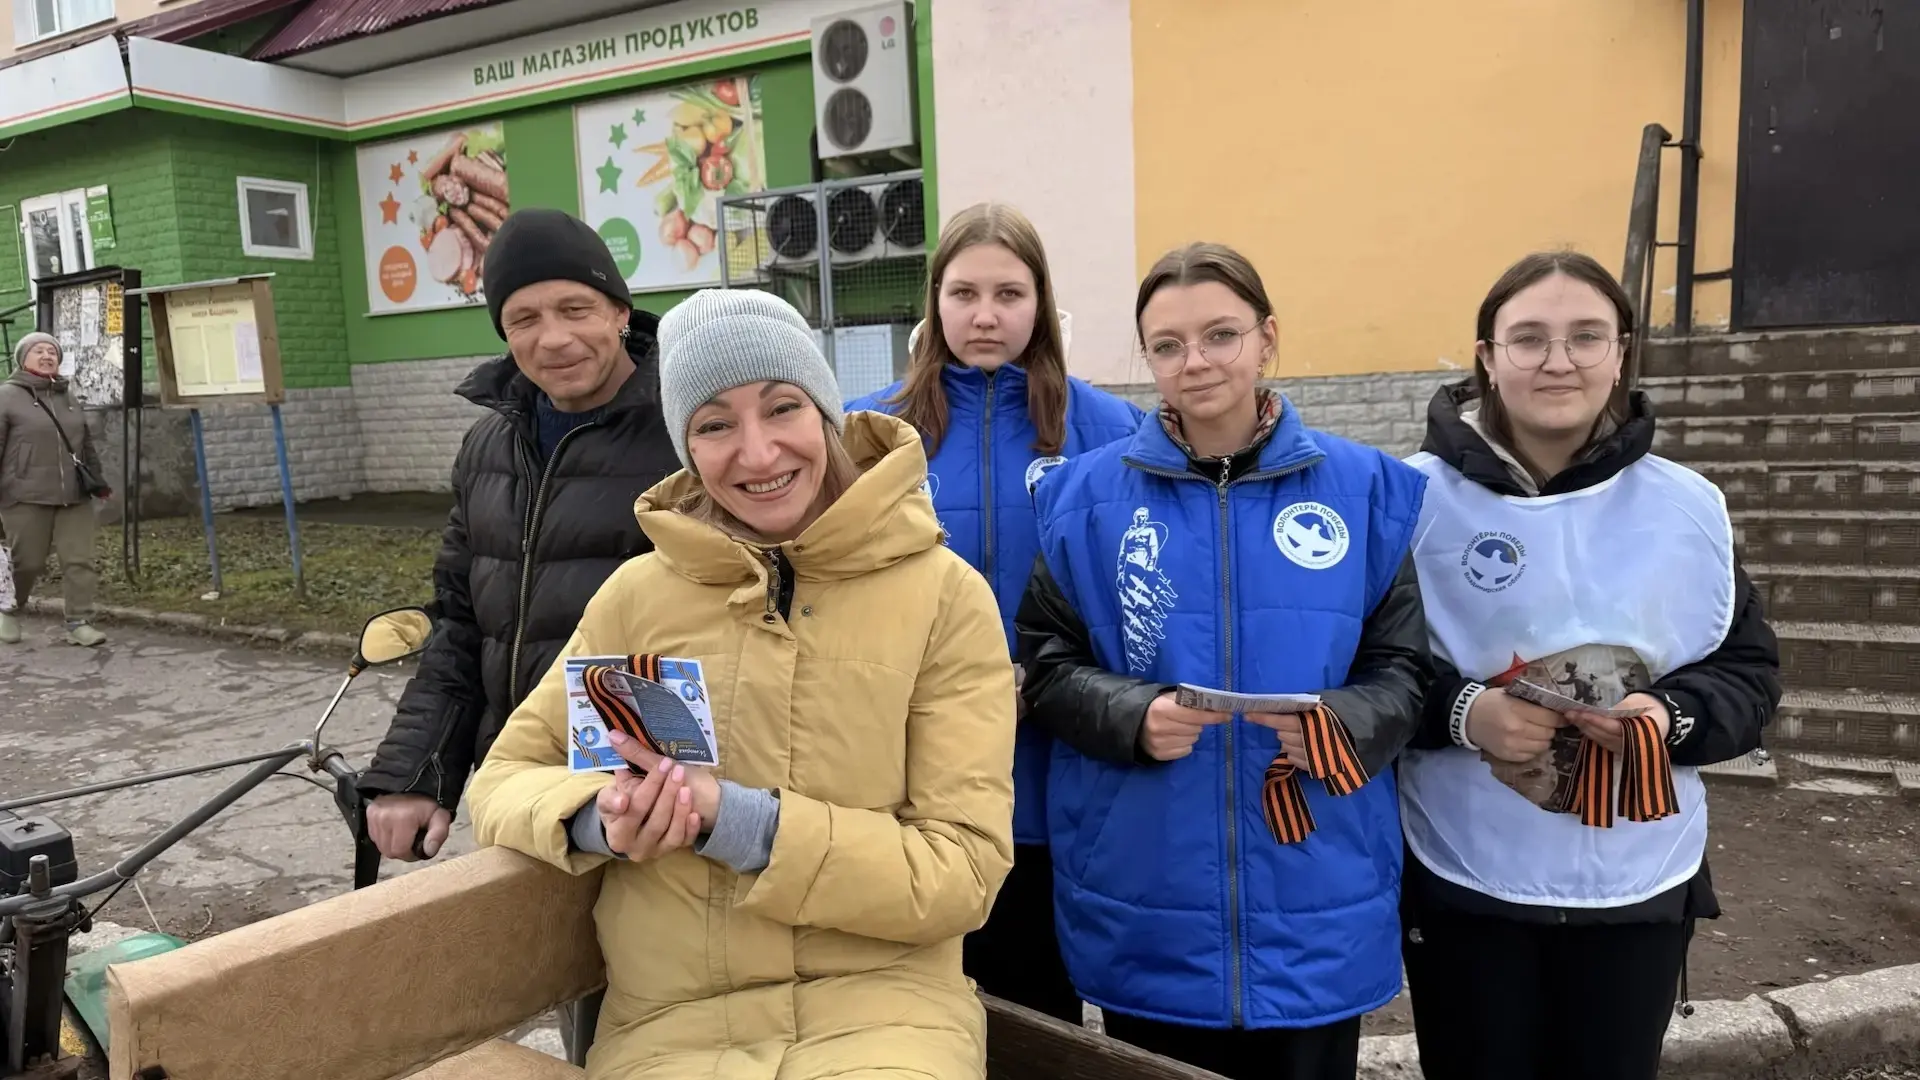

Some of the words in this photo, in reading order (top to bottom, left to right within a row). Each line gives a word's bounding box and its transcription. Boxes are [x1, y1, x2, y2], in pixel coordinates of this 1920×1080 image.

[473, 60, 515, 86] ВАШ
[522, 37, 617, 77] МАГАЗИН
[625, 7, 760, 55] ПРОДУКТОВ
[881, 38, 896, 50] LG
[1028, 457, 1062, 481] ВОЛОНТЕРЫ
[1277, 504, 1318, 533] ВОЛОНТЕРЫ
[1320, 507, 1347, 539] ПОБЕДЫ
[1461, 531, 1498, 566] ВОЛОНТЕРЫ
[1499, 531, 1527, 557] ПОБЕДЫ
